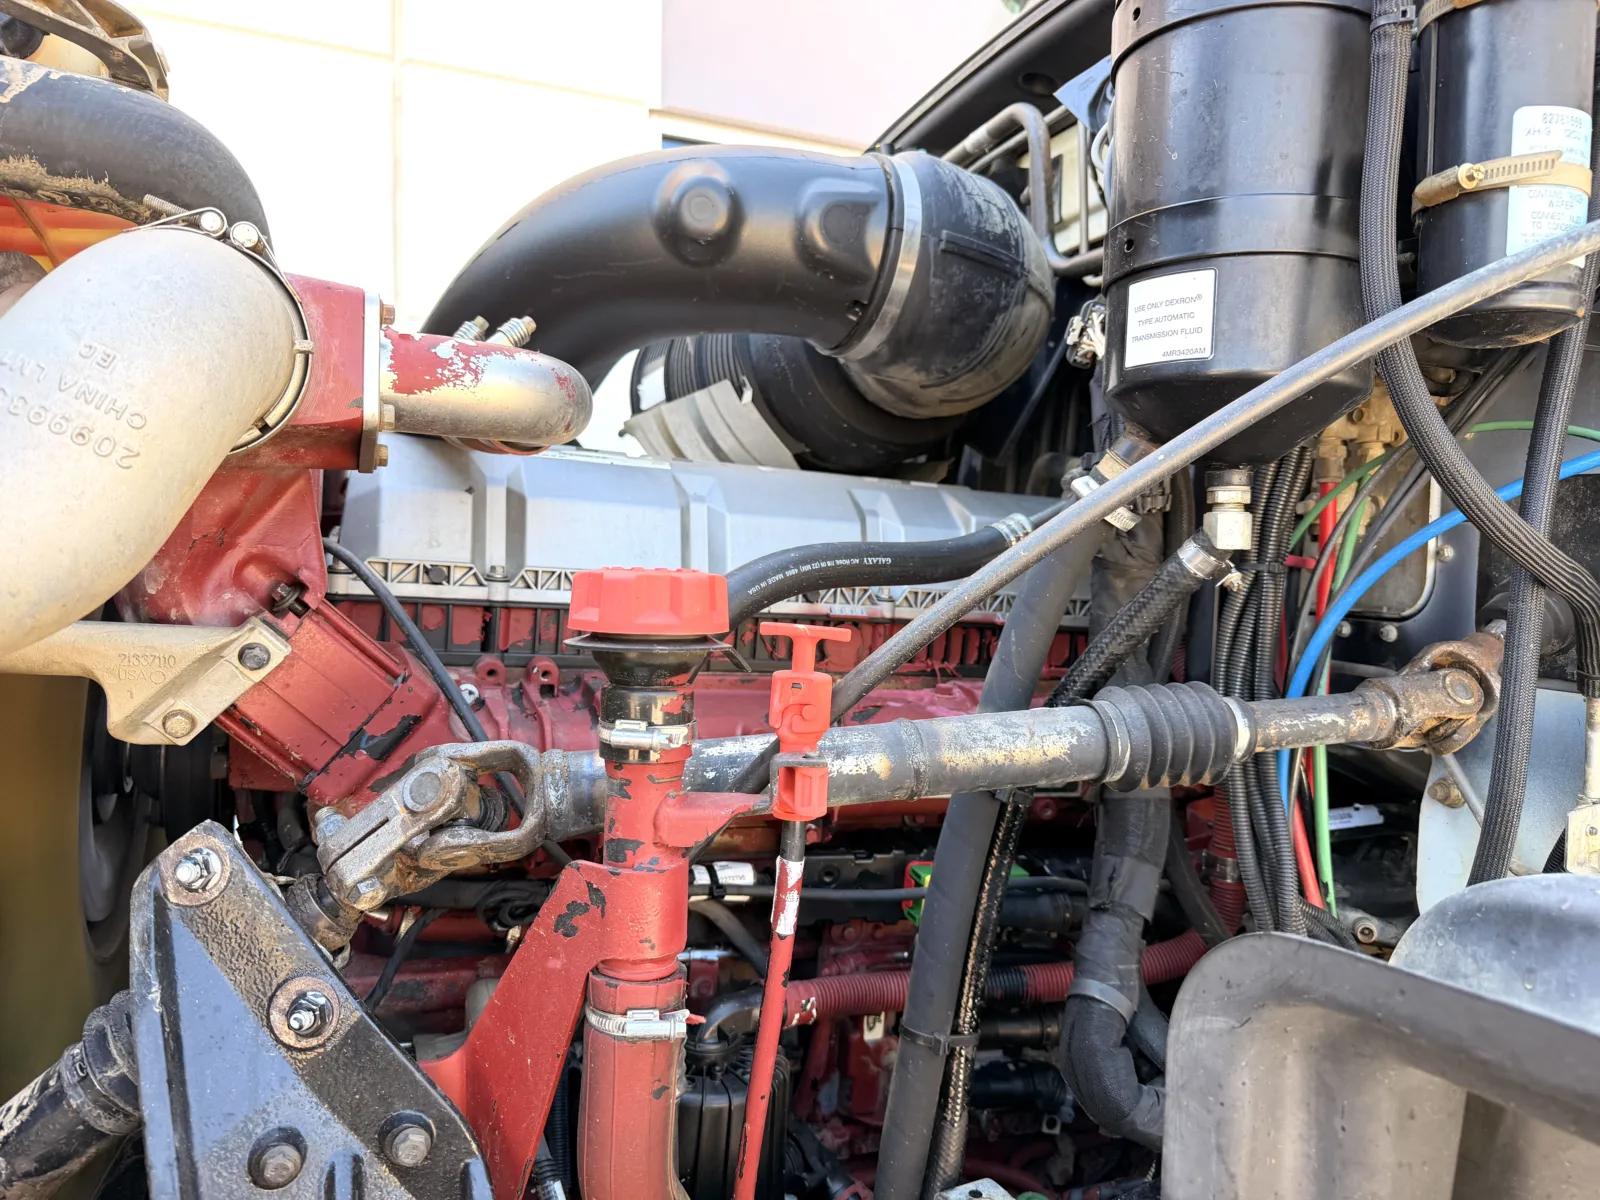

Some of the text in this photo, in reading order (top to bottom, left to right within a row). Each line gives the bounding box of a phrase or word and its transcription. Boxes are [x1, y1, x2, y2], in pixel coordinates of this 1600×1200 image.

[1134, 304, 1146, 313] USE
[1146, 301, 1164, 310] ONLY
[1138, 312, 1195, 327] TYPE AUTOMATIC
[1132, 327, 1203, 343] TRANSMISSION FLUID
[58, 372, 147, 430] CHINA
[863, 557, 892, 565] GALAXY
[760, 580, 767, 588] IN
[767, 574, 784, 584] MADE
[747, 585, 760, 595] USA
